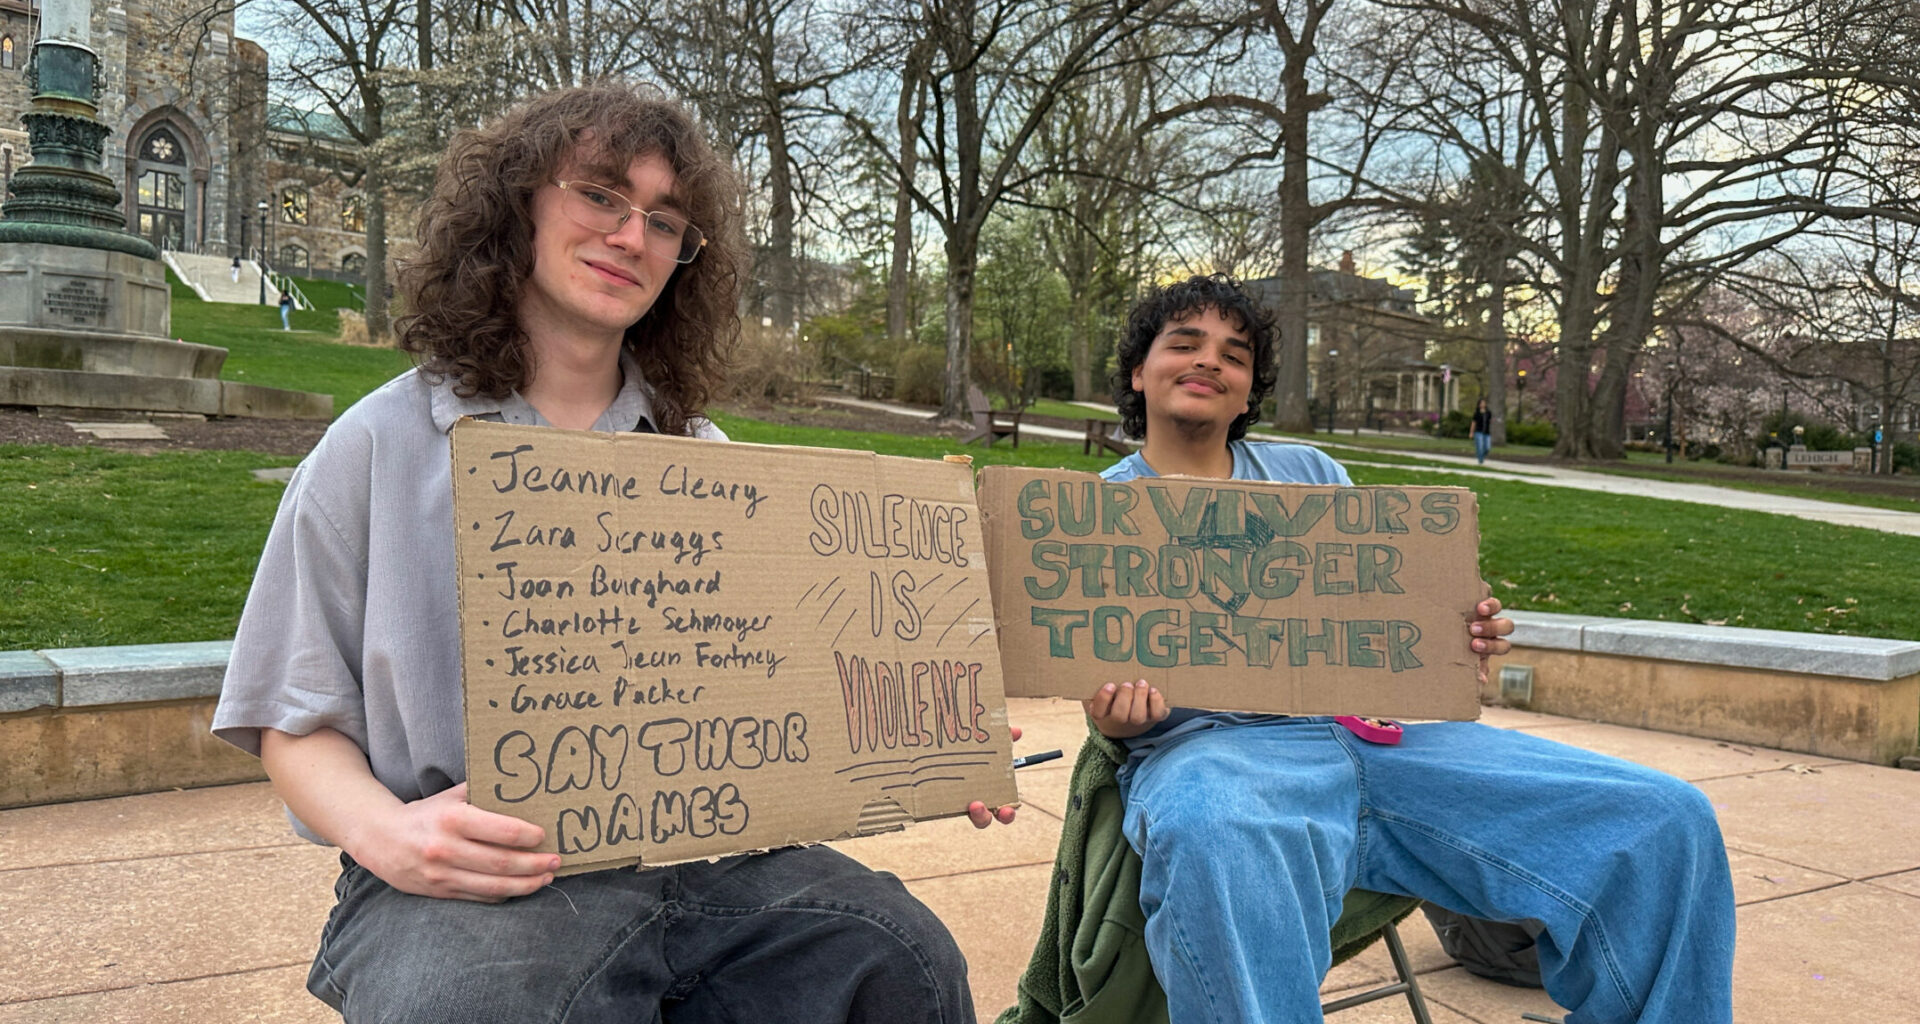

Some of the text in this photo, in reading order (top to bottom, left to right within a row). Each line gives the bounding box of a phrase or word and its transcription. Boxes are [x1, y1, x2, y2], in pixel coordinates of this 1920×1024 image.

[490, 444, 768, 519] Jeanne Cleary
[1795, 454, 1838, 463] LEHIGH
[490, 510, 723, 566] Zara Scruggs
[809, 483, 969, 568] SILENCE
[1017, 479, 1461, 540] SURVIVORS
[496, 561, 721, 608] Joan Burghard
[1024, 541, 1405, 600] STRONGER
[502, 606, 641, 638] Charlotte
[870, 569, 922, 641] IS
[505, 640, 787, 678] Jessica Jean Fortney
[1031, 605, 1424, 673] TOGETHER
[511, 676, 706, 713] Grace Packer
[835, 651, 990, 754] VIOLENCE
[494, 712, 811, 803] SAY THEIR
[556, 783, 750, 855] NAMES
